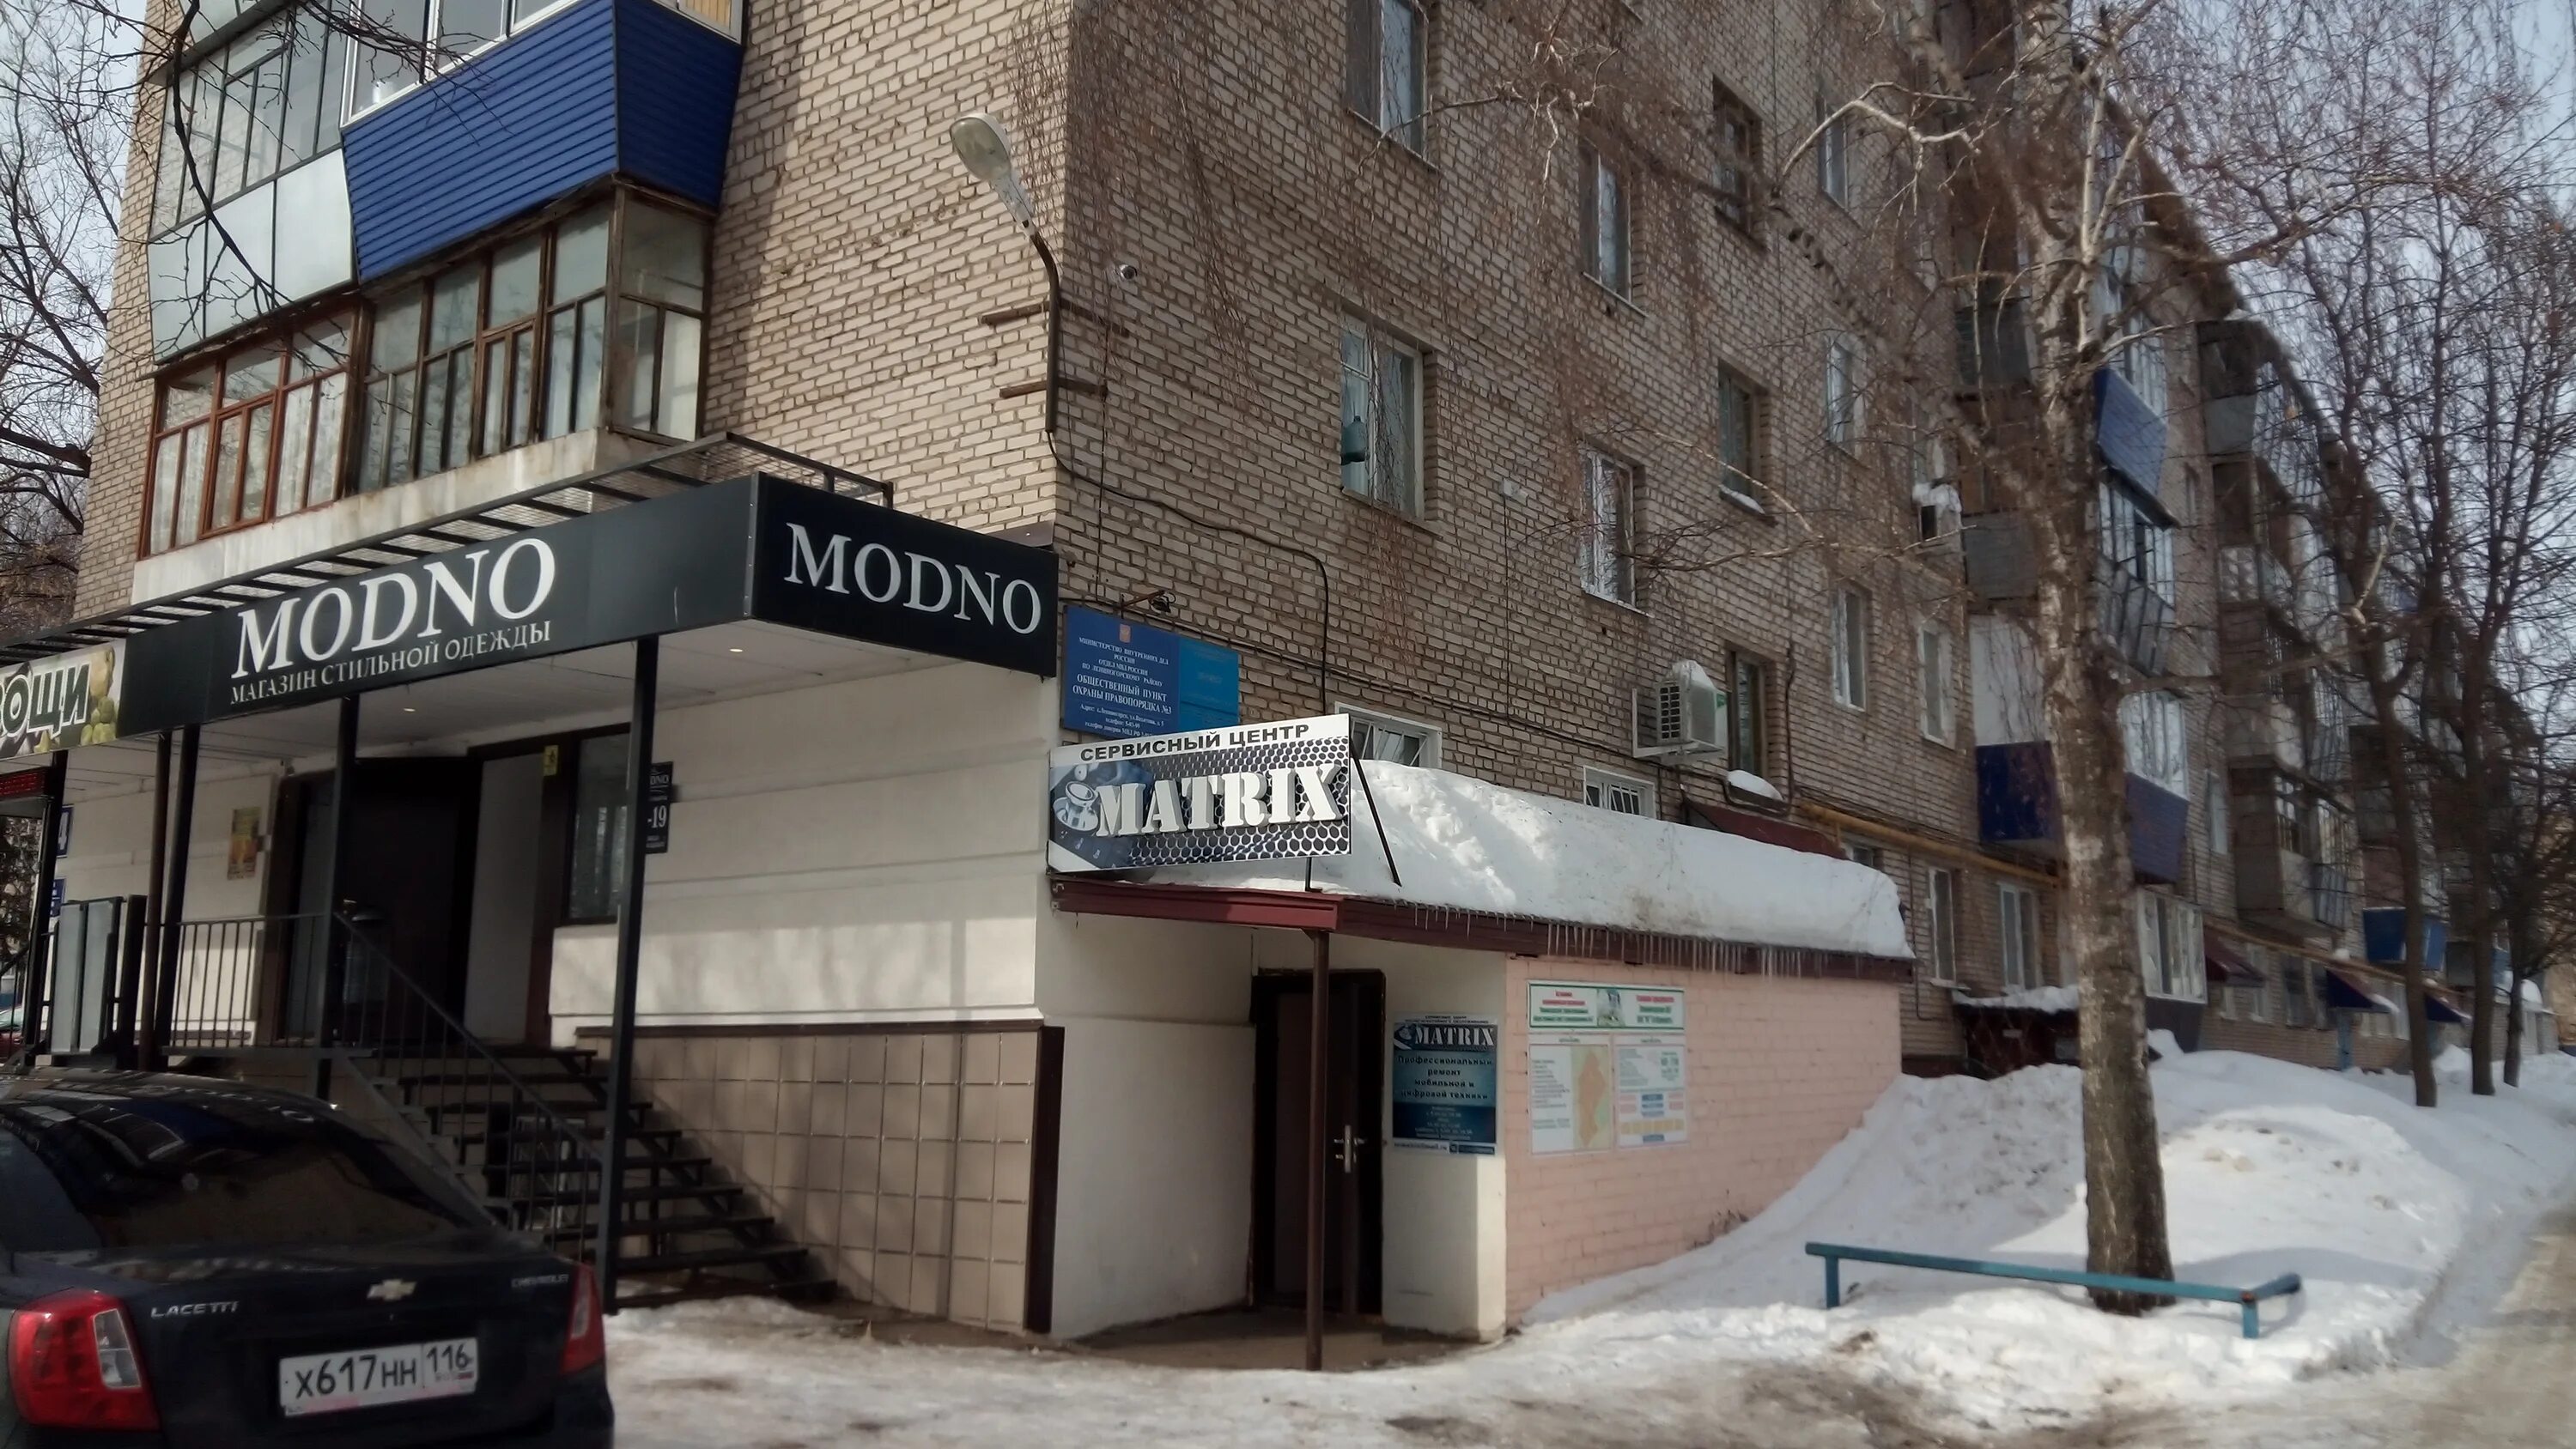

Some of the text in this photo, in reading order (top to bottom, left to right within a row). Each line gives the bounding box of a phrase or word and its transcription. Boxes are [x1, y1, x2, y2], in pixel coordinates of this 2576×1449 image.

[784, 523, 1042, 635] MODNO
[230, 537, 556, 679] MODNO
[231, 621, 552, 705] МАГАЗИН СТИЛЬНОЙ ОДЕЖДЫ
[1072, 685, 1103, 700] ОХРАНЫ
[1105, 692, 1160, 712] ПРАВОПОРЯДКА
[1077, 673, 1140, 696] ОБЩЕСТВЕННЫЙ
[1143, 688, 1168, 702] ПУНКТ
[1080, 724, 1309, 761] СЕРВИСНЫЙ ЦЕНТР
[1096, 763, 1342, 837] MATRIX
[1415, 1026, 1495, 1047] MATRIX
[1414, 1079, 1466, 1088] мобильной
[1427, 1068, 1461, 1077] ремонт
[1400, 1088, 1448, 1100] цифровой
[150, 1300, 240, 1319] LACETTI
[425, 1343, 470, 1373] 116
